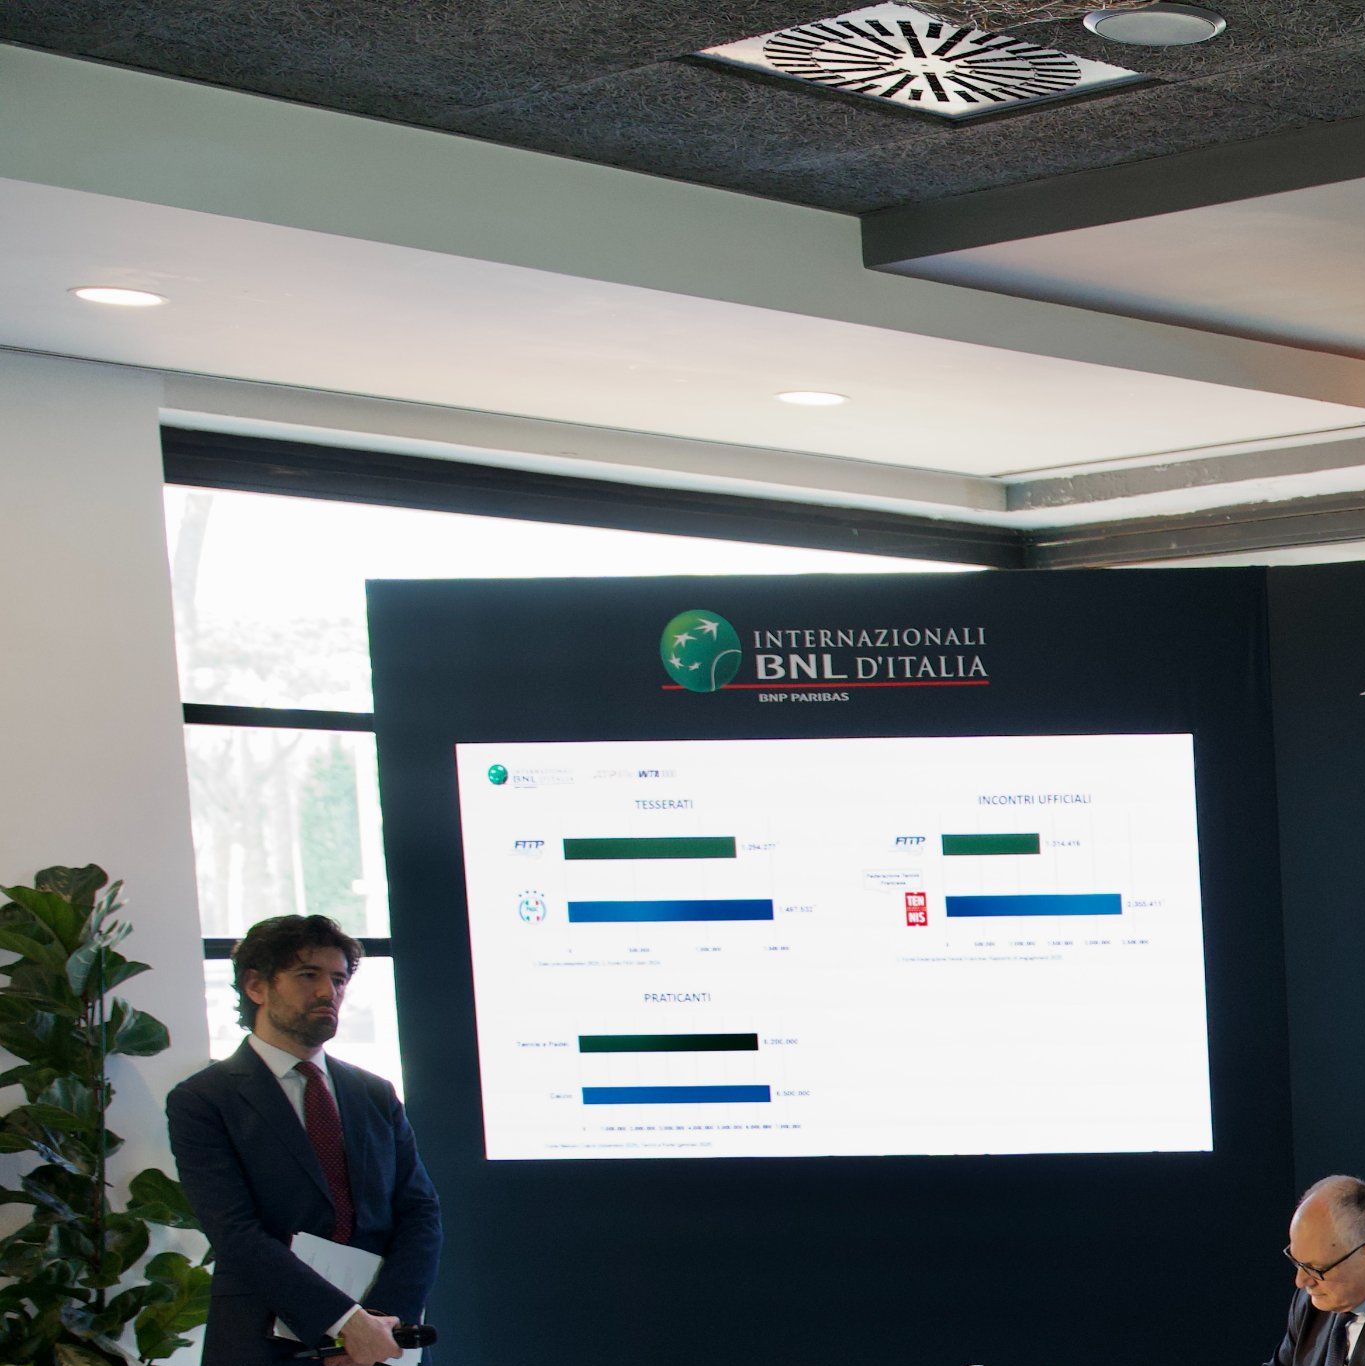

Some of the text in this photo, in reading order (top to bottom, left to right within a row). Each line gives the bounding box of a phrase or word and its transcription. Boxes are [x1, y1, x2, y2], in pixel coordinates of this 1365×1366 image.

[754, 627, 988, 649] INTERNAZIONALI
[756, 653, 989, 680] BNL D'ITALIA
[758, 691, 850, 703] BNP PARIBAS
[635, 799, 694, 810] TESSERATI
[978, 793, 1092, 806] INCONTRI UFFICIALI
[907, 895, 925, 907] TEN
[908, 912, 926, 924] NIS
[644, 993, 711, 1003] PRATICANTI
